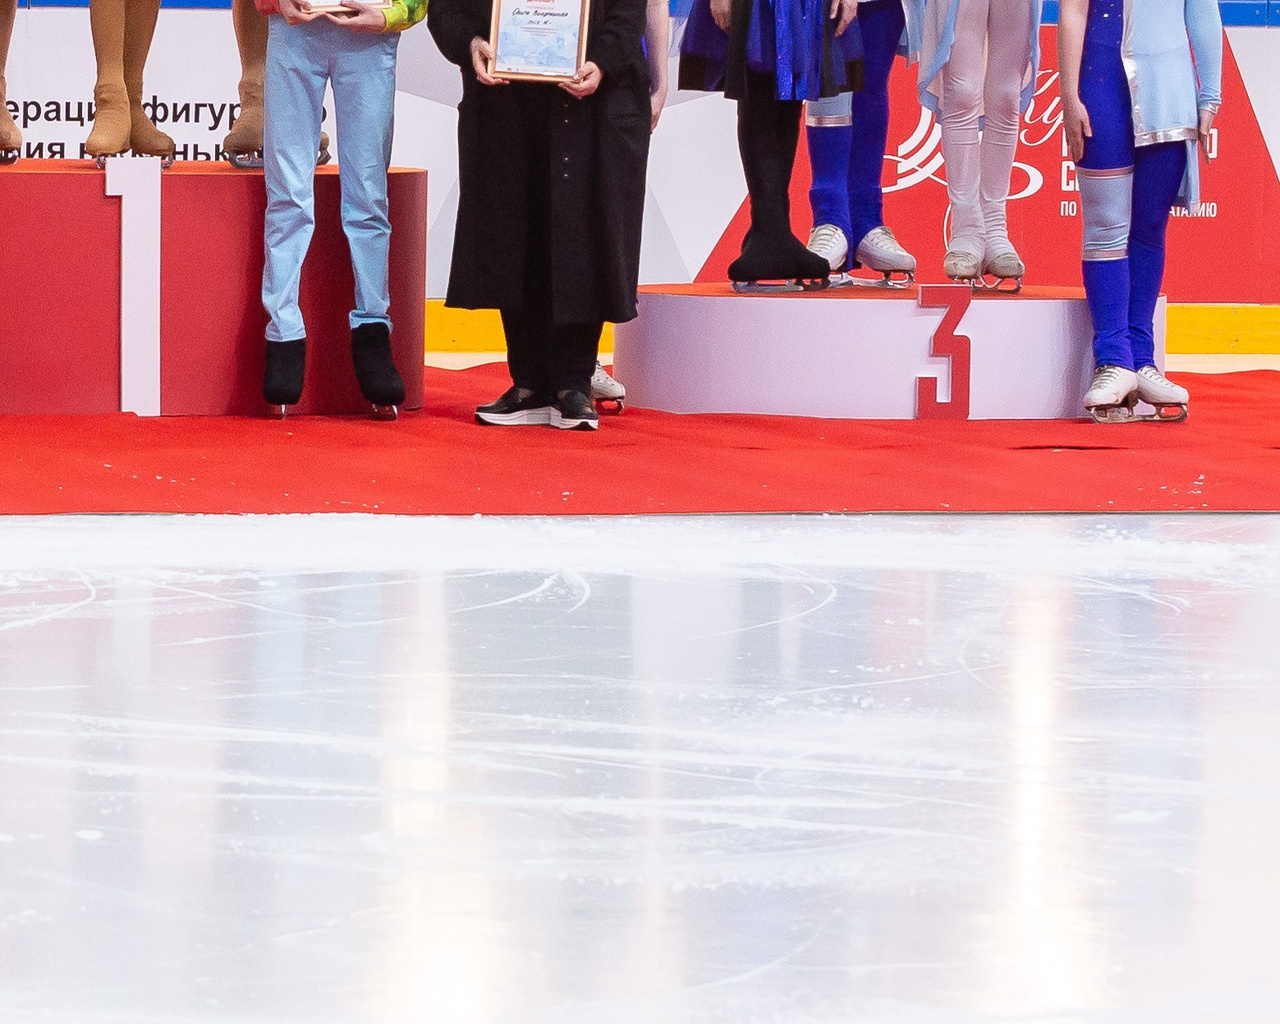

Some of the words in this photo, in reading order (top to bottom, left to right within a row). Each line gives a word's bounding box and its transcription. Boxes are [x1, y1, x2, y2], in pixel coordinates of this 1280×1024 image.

[1060, 200, 1077, 216] ПО
[105, 157, 162, 417] 1
[917, 285, 972, 420] 3
